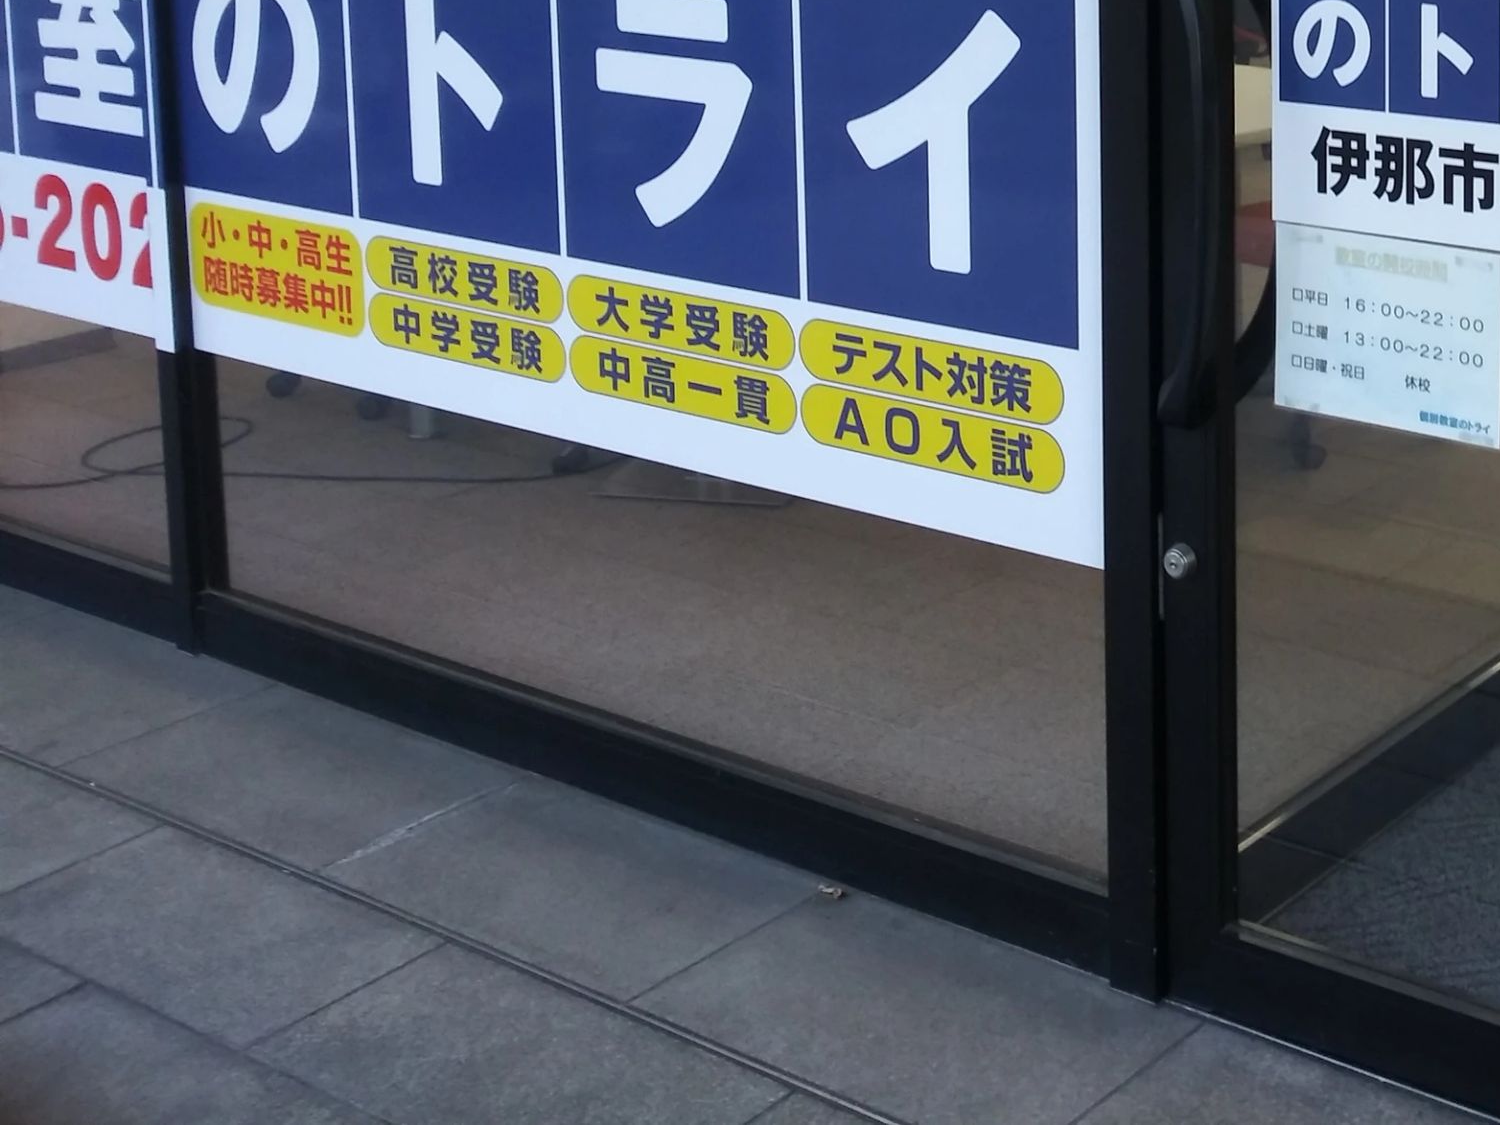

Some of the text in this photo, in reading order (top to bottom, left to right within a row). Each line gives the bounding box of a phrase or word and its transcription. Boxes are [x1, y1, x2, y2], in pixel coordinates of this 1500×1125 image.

[200, 210, 353, 277] 小・中・高生
[388, 245, 541, 314] 高校受験
[392, 304, 544, 375] 中学受験
[594, 285, 770, 362] 大学受験
[598, 346, 771, 426] 中高一貫
[832, 331, 1032, 414] テスト対策
[833, 397, 1033, 483] AO入試
